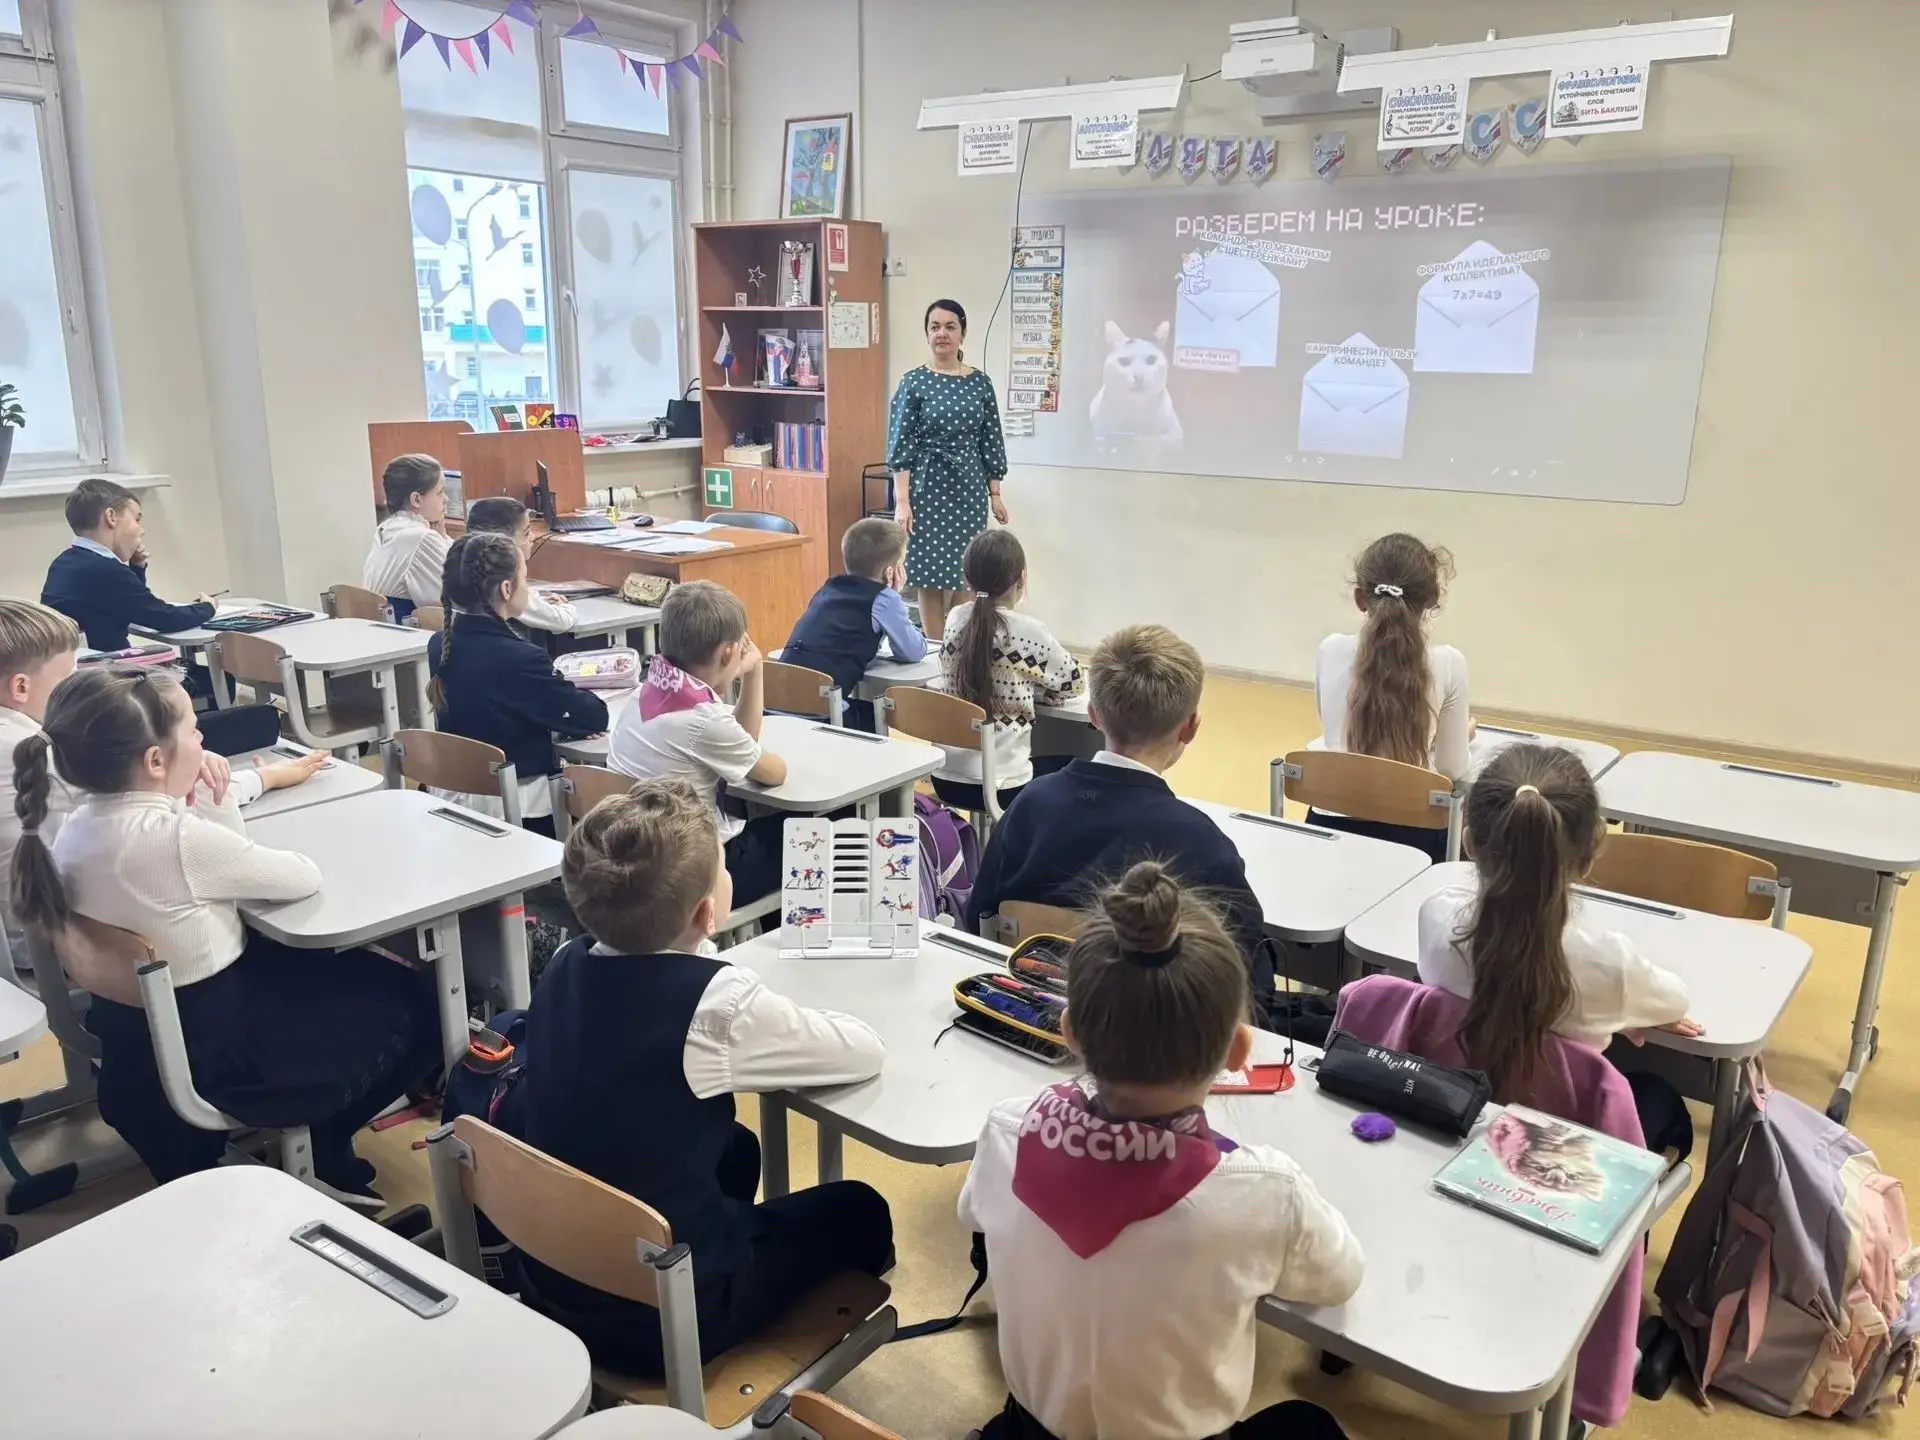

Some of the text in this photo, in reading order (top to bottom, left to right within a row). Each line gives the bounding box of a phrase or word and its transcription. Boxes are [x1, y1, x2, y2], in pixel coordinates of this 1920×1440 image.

[1389, 92, 1457, 108] ОМОНИМЫ
[1559, 87, 1636, 100] УСТОЙЧИВОЕ СОЧЕТАНИЕ
[1600, 105, 1638, 114] БАКЛУШИ
[1175, 203, 1485, 237] РАЗБЕРЕМ НА УРОКЕ:
[1200, 230, 1247, 247] КОМАНДА
[1254, 239, 1273, 250] ЭТО
[1274, 243, 1331, 261] МЕХАНИЗМ
[1225, 248, 1308, 268] ШЕСТЕРЕНКАМИ?
[1418, 260, 1471, 275] ФОРМУЛА
[1444, 265, 1521, 283] КОЛЛЕКТИВА?
[1334, 356, 1387, 367] КОМАНДЕ?
[1014, 391, 1036, 404] ENGLISH
[1367, 1048, 1378, 1060] BE
[1404, 1079, 1417, 1095] KITE
[1019, 1110, 1176, 1162] РОССИИ
